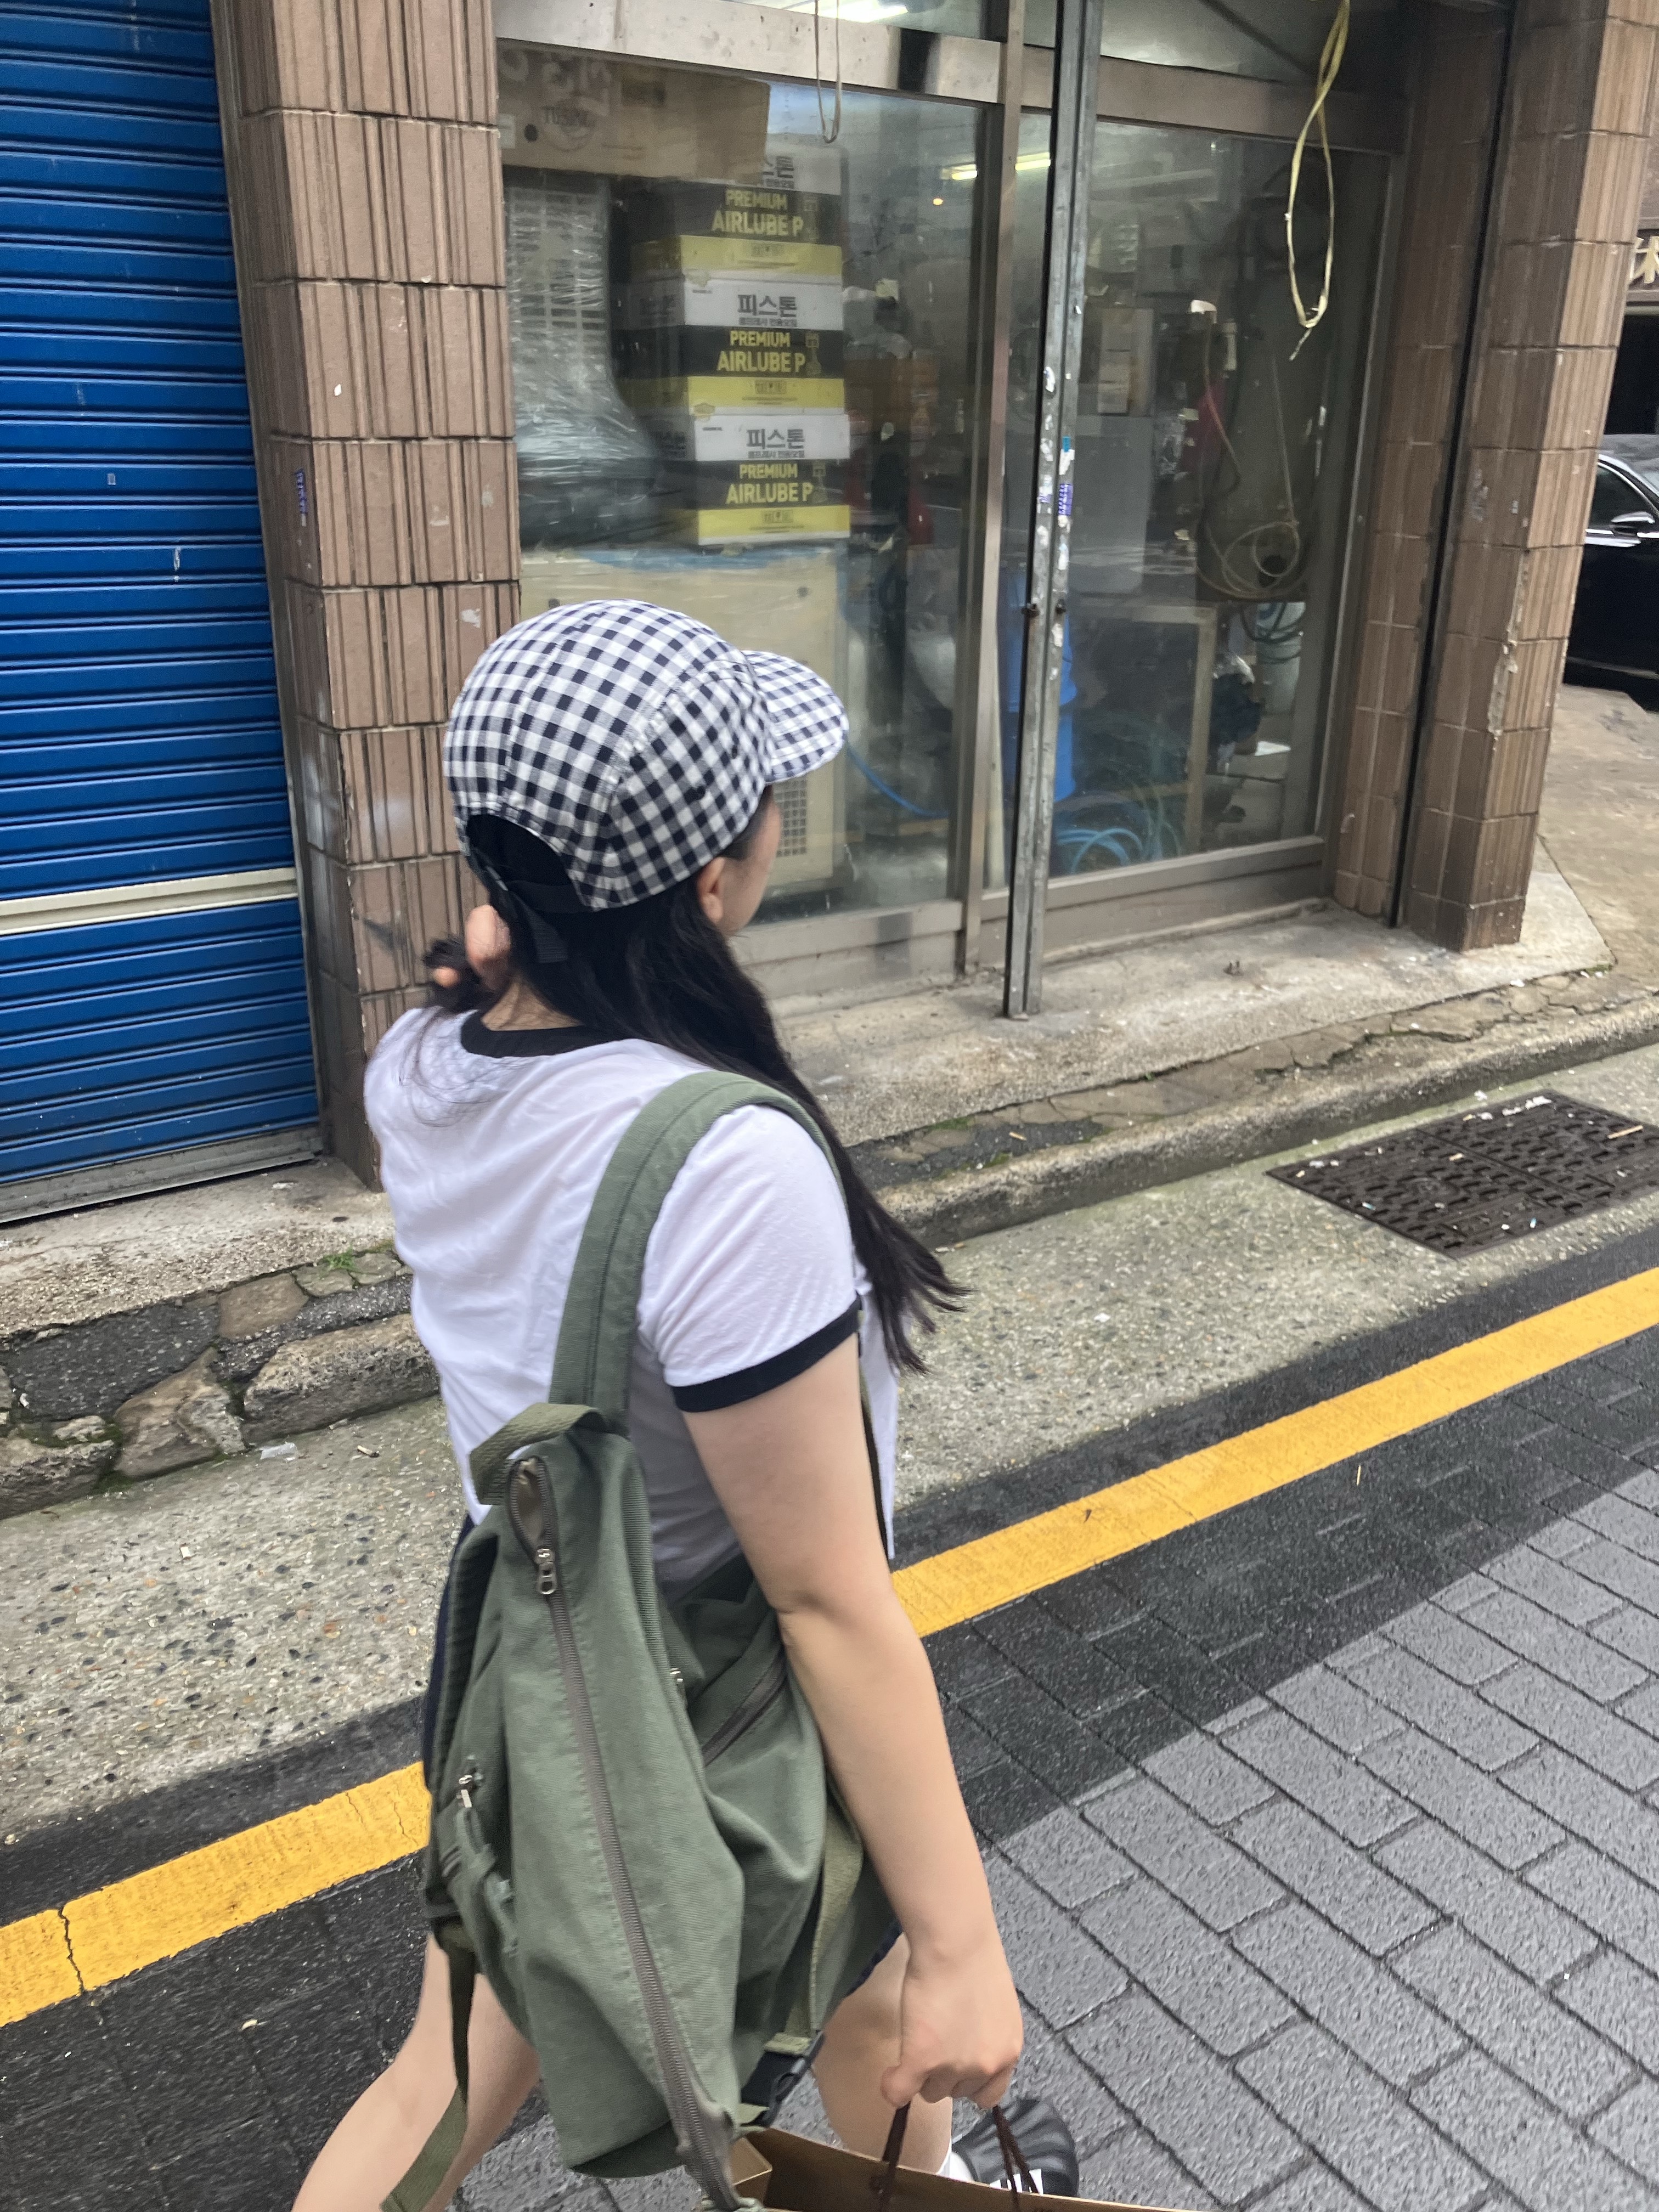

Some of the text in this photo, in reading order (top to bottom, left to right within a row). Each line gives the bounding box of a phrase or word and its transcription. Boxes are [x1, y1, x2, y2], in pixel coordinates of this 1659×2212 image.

[725, 189, 787, 210] PREMIUM
[712, 209, 804, 237] AIRLUBE P
[737, 294, 798, 318] 피스톤
[730, 330, 791, 348] PREMIUM
[716, 350, 806, 373] AIRLUBE P
[746, 428, 805, 450] 피스톤
[740, 462, 798, 479] PREMIUM
[725, 482, 814, 505] AIRLUBE P
